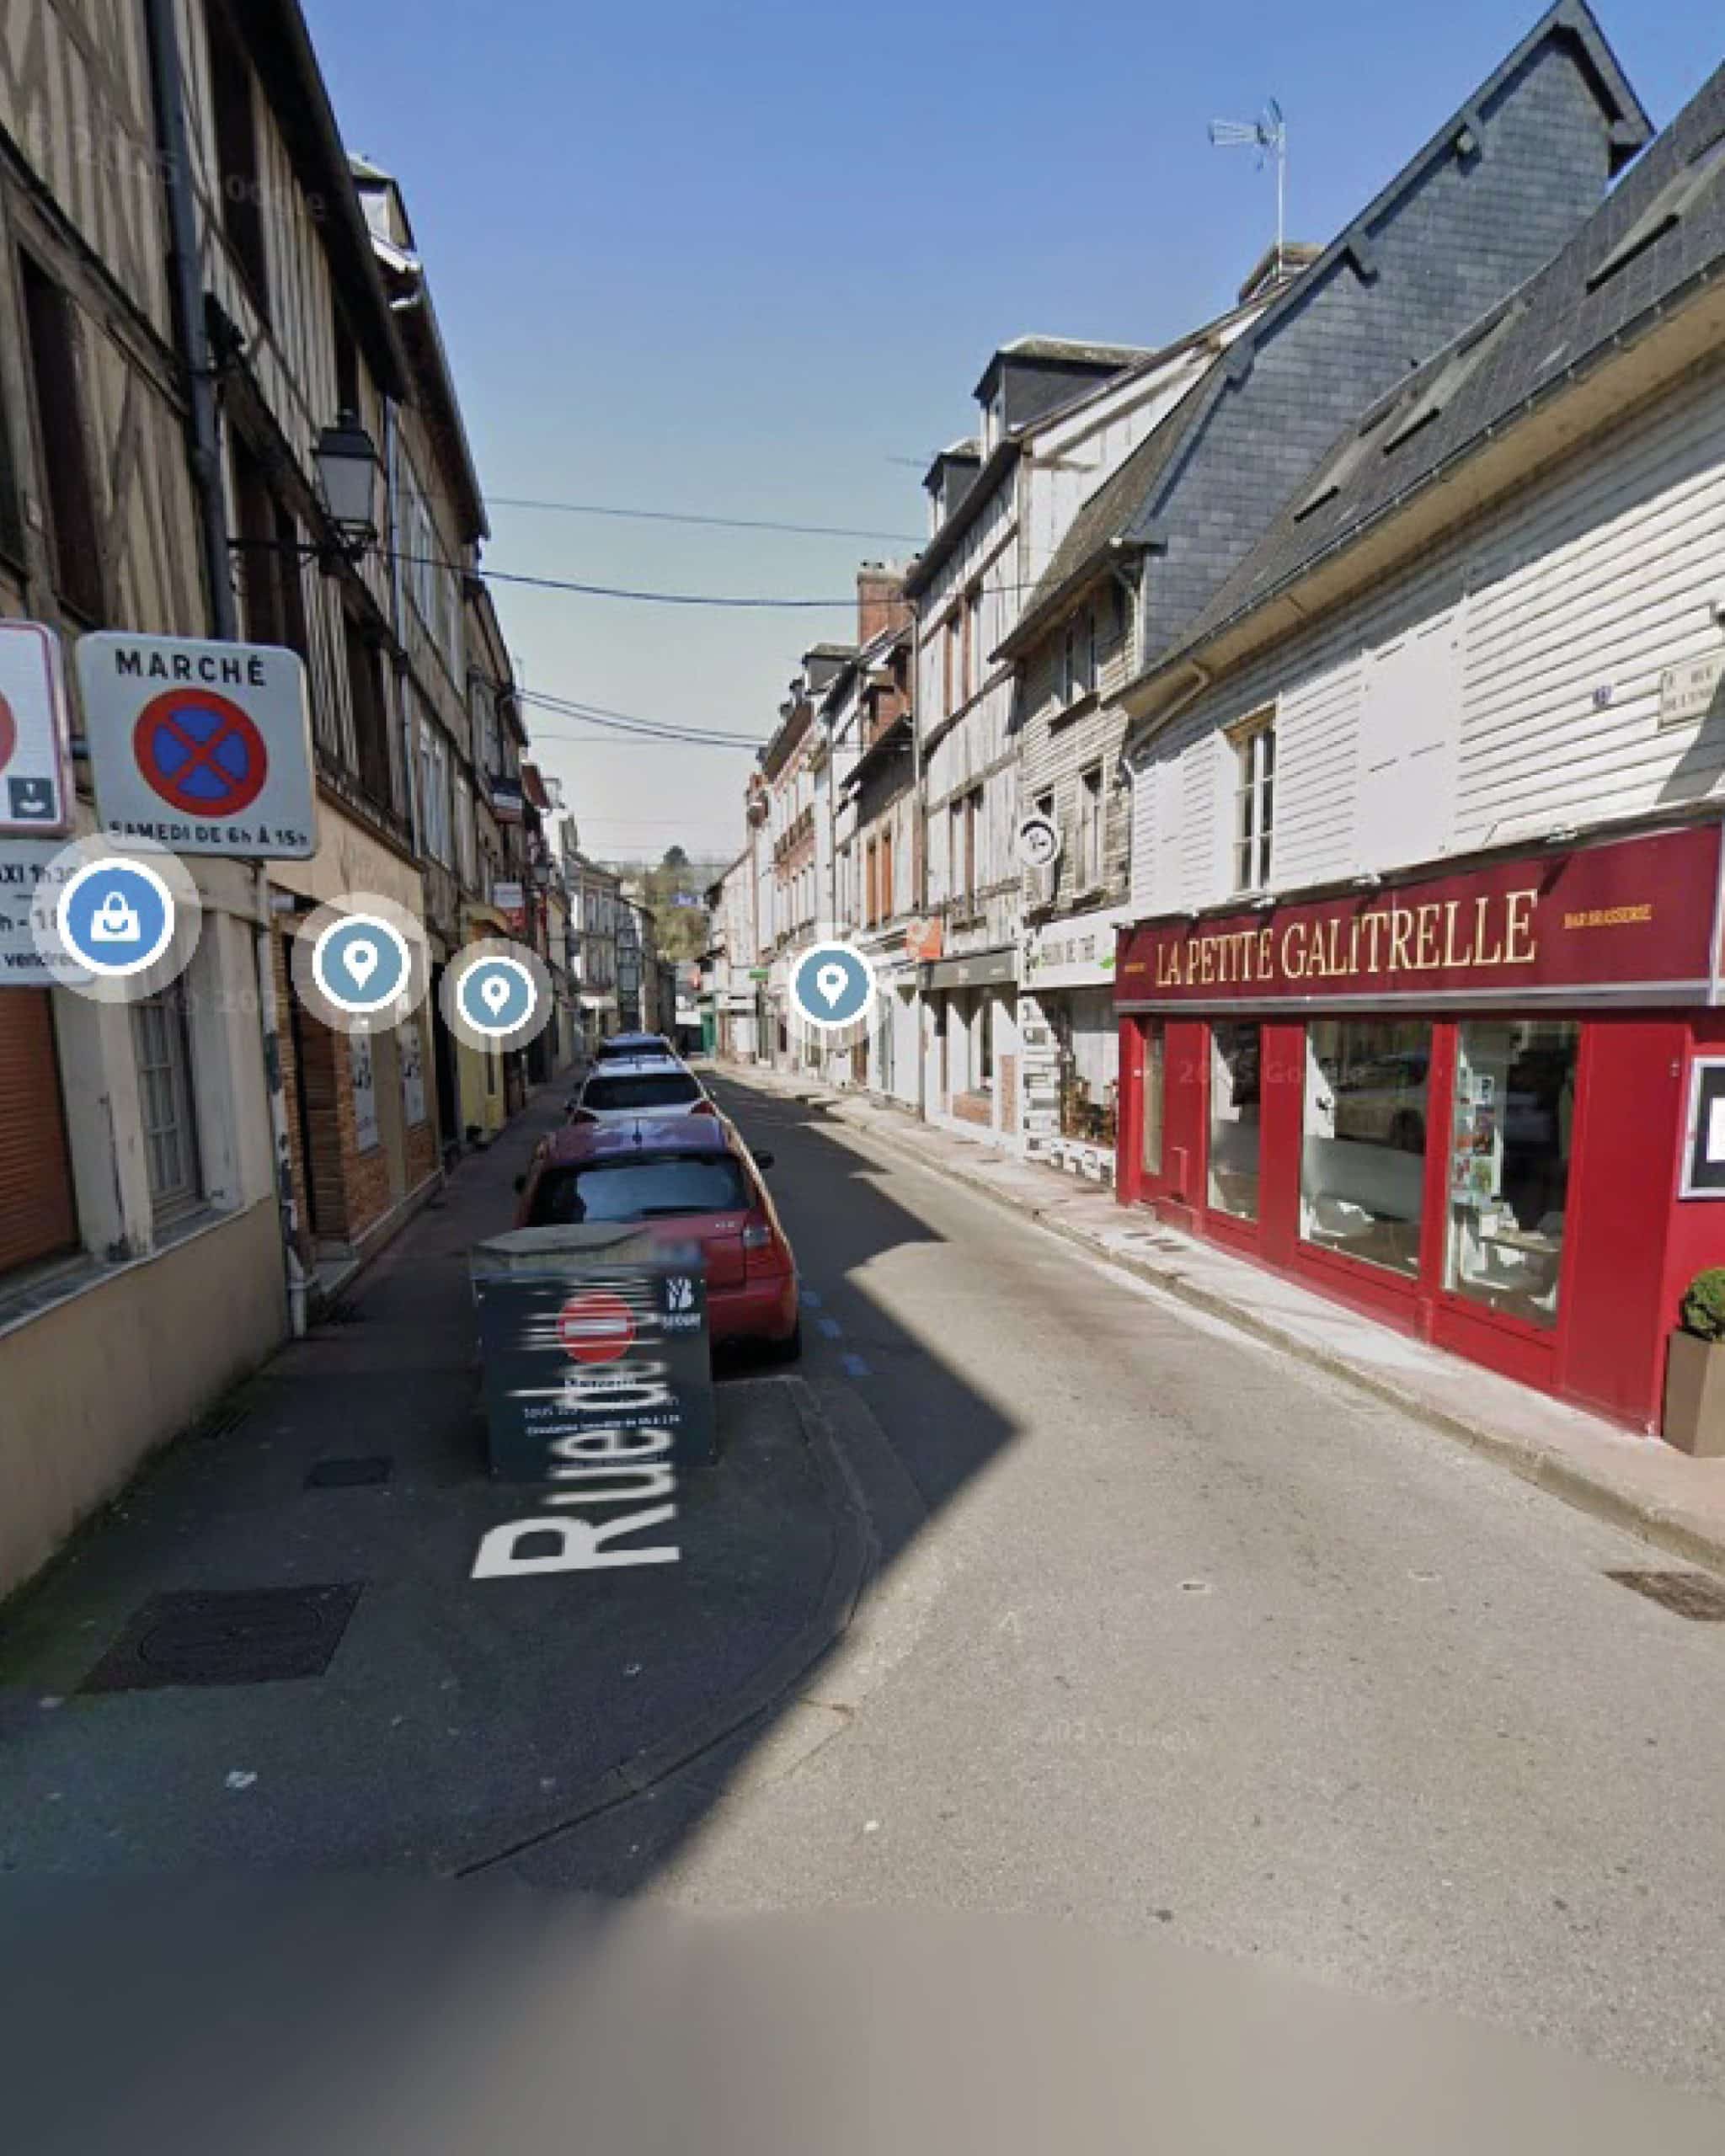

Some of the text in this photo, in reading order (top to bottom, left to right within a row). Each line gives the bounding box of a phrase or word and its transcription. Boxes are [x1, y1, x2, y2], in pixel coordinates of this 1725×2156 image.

[115, 648, 266, 686] MARCHÉ
[109, 820, 190, 841] SAMEDI
[195, 826, 221, 843] DE
[1155, 942, 1181, 987] LA
[1186, 928, 1274, 985] PETITE
[1281, 889, 1539, 979] GALITRELLE
